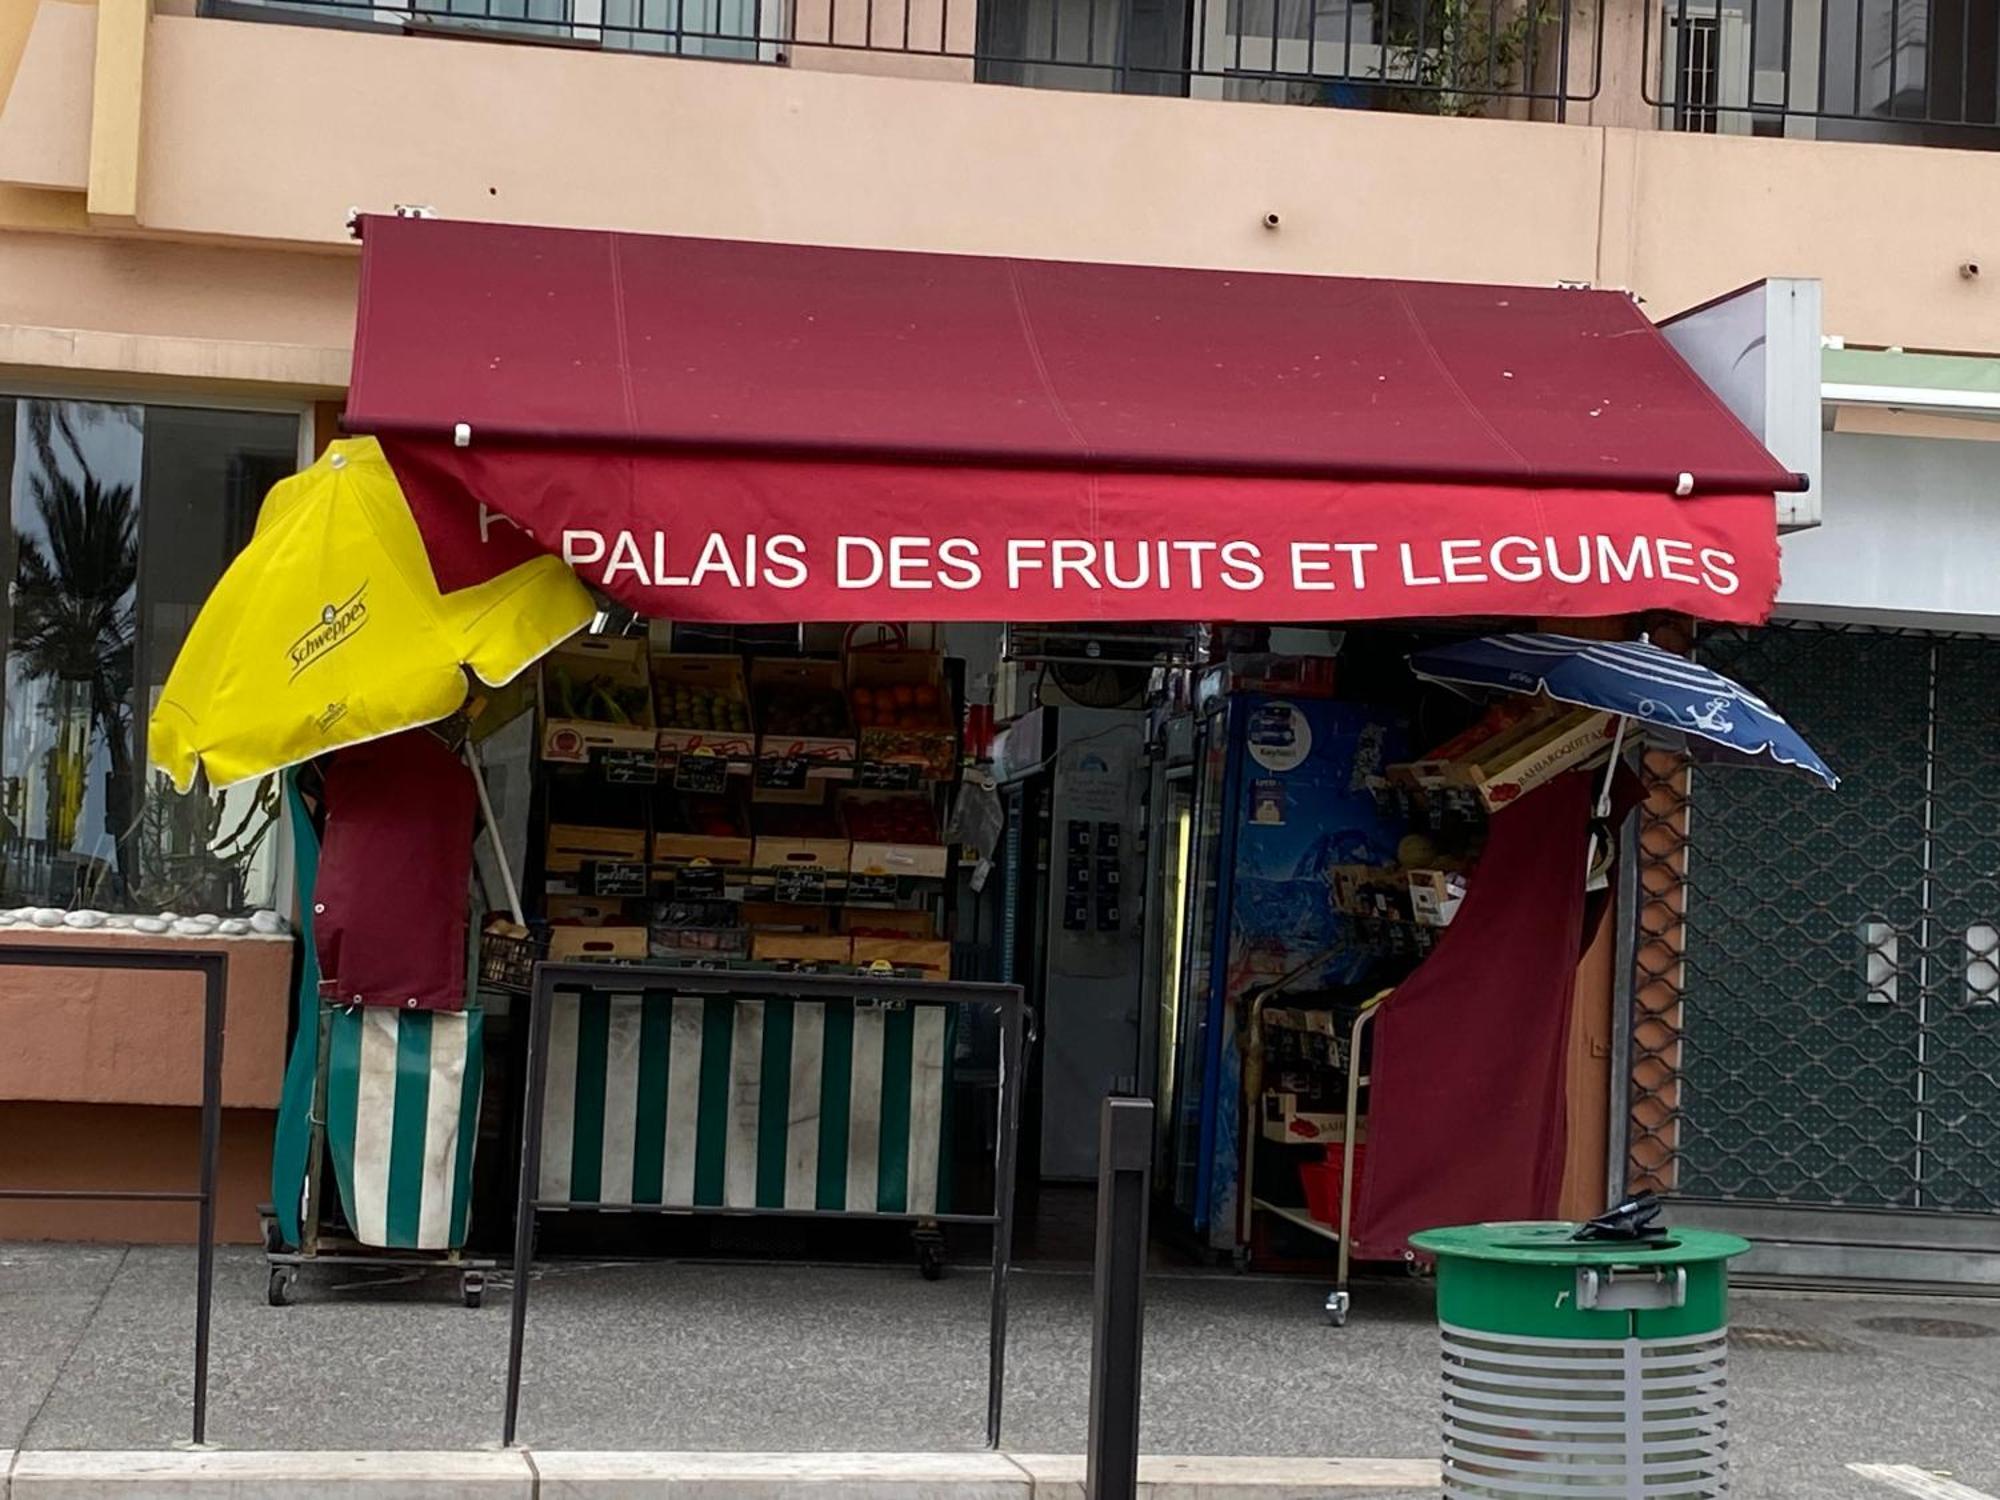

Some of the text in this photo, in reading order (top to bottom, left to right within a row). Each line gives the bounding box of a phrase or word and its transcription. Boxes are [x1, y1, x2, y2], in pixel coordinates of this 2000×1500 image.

[562, 530, 1740, 595] PALAIS DES FRUITS ET LEGUMES
[291, 596, 367, 671] Schweppes
